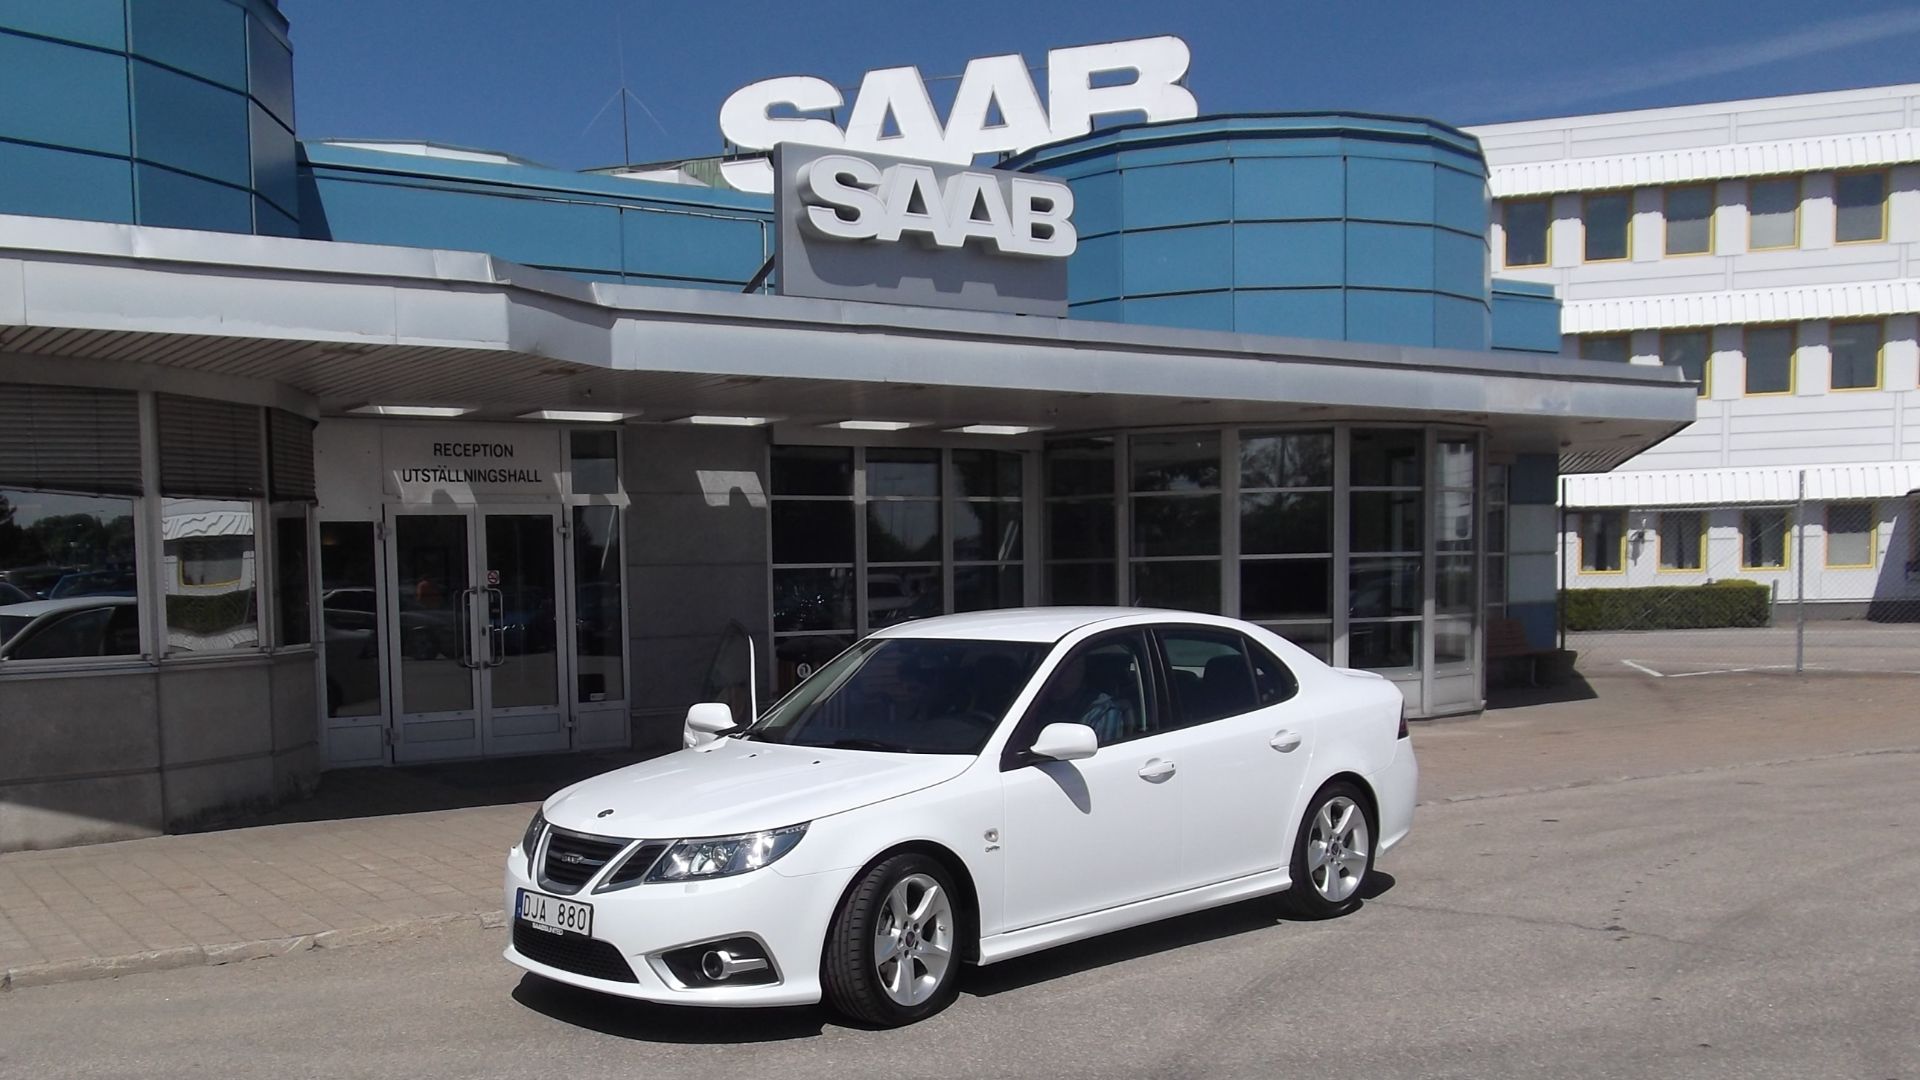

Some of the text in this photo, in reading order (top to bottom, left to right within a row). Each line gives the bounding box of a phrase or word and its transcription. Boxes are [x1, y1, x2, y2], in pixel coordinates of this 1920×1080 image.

[719, 35, 1199, 194] SAAB
[800, 155, 1078, 258] SAAB
[433, 442, 514, 458] RECEPTION
[402, 465, 542, 483] UTSTÄLLNINGSHALL
[523, 894, 546, 922] DJA
[557, 903, 587, 931] 880
